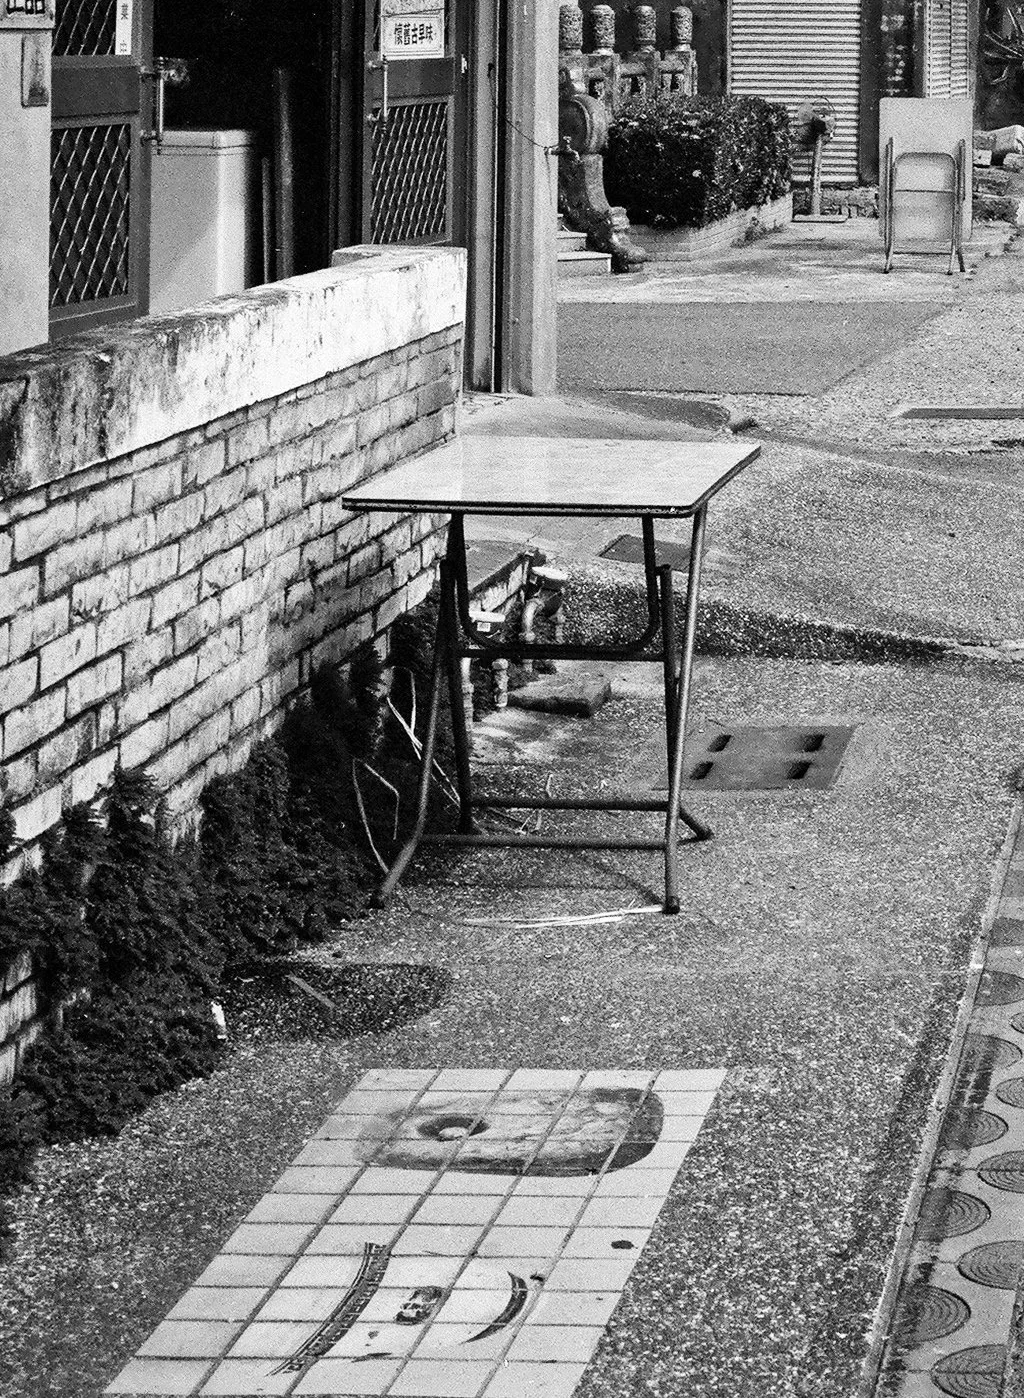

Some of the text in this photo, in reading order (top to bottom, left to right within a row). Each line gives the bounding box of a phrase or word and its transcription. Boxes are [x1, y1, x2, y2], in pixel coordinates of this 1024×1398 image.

[394, 22, 434, 46] 懷舊古早味
